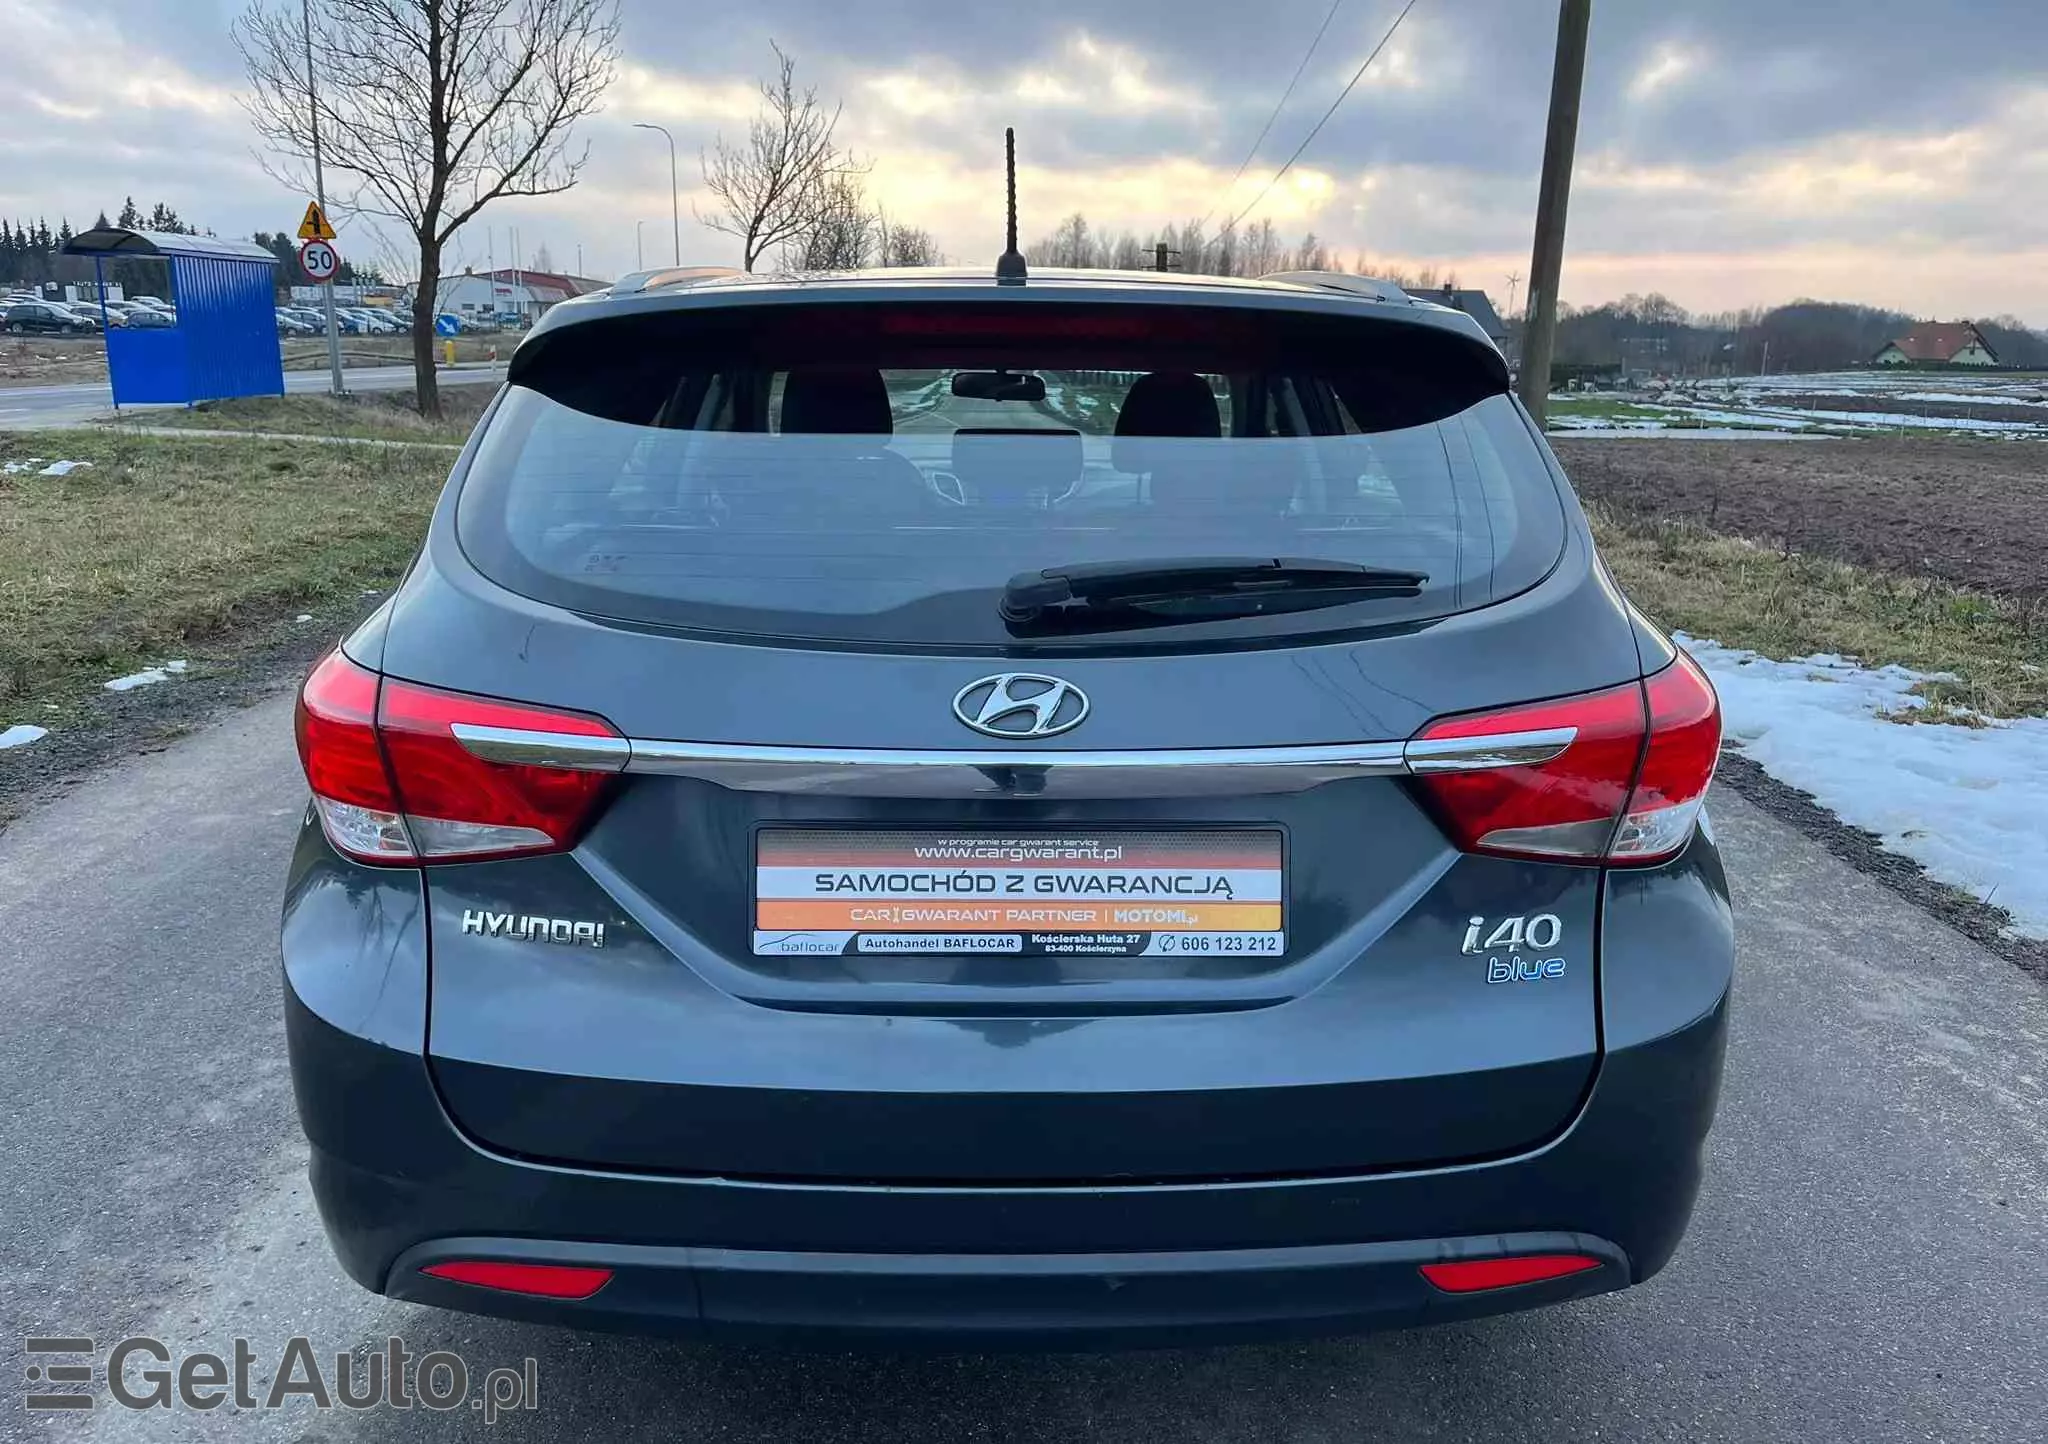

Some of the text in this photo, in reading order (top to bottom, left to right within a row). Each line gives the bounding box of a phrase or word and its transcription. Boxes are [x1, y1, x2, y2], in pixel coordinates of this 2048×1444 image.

[308, 250, 332, 270] 50
[949, 838, 999, 847] programie
[1019, 838, 1061, 847] gwarant
[915, 846, 1122, 862] www.cargwarant.pl
[815, 870, 1234, 900] SAMOCHÓD Z GWARANCJĄ
[1006, 910, 1096, 922] PARTNER
[462, 909, 604, 948] HYUNDAI
[1461, 914, 1562, 954] i40
[865, 938, 1015, 949] Autohandel BAFLOCAR
[1031, 934, 1141, 944] Kościerska Huta 27
[1182, 936, 1276, 951] 606 123 212
[781, 941, 840, 953] baflocar
[1487, 956, 1566, 984] blue
